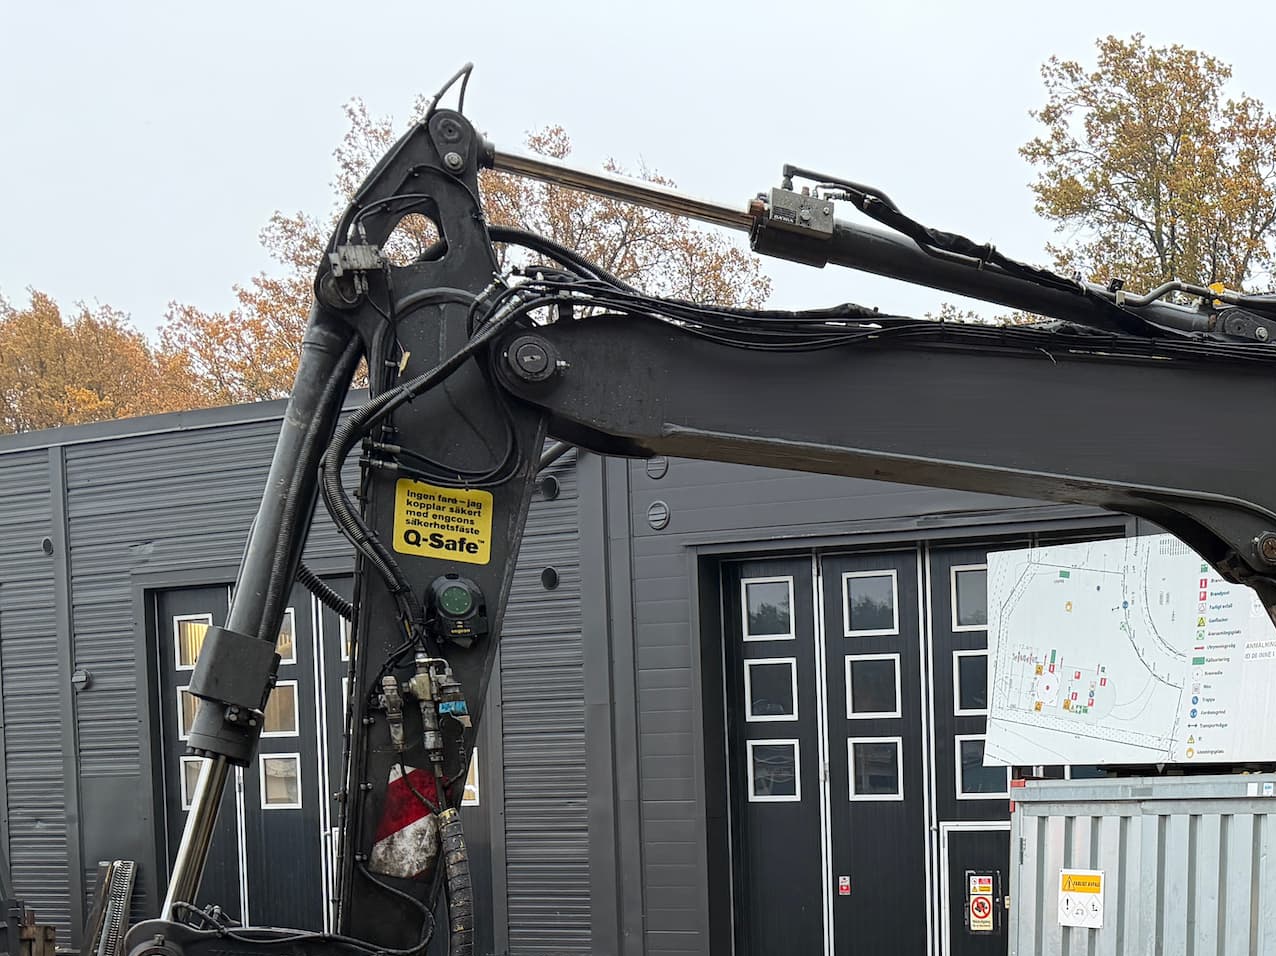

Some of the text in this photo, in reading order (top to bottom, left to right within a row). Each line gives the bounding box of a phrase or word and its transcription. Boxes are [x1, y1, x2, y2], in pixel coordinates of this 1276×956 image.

[406, 498, 481, 518] kopplar säkert
[407, 489, 435, 500] Ingen
[438, 494, 457, 504] fara
[467, 498, 482, 510] jag
[405, 517, 480, 535] säkerhetsfäste
[406, 509, 475, 525] med engcons
